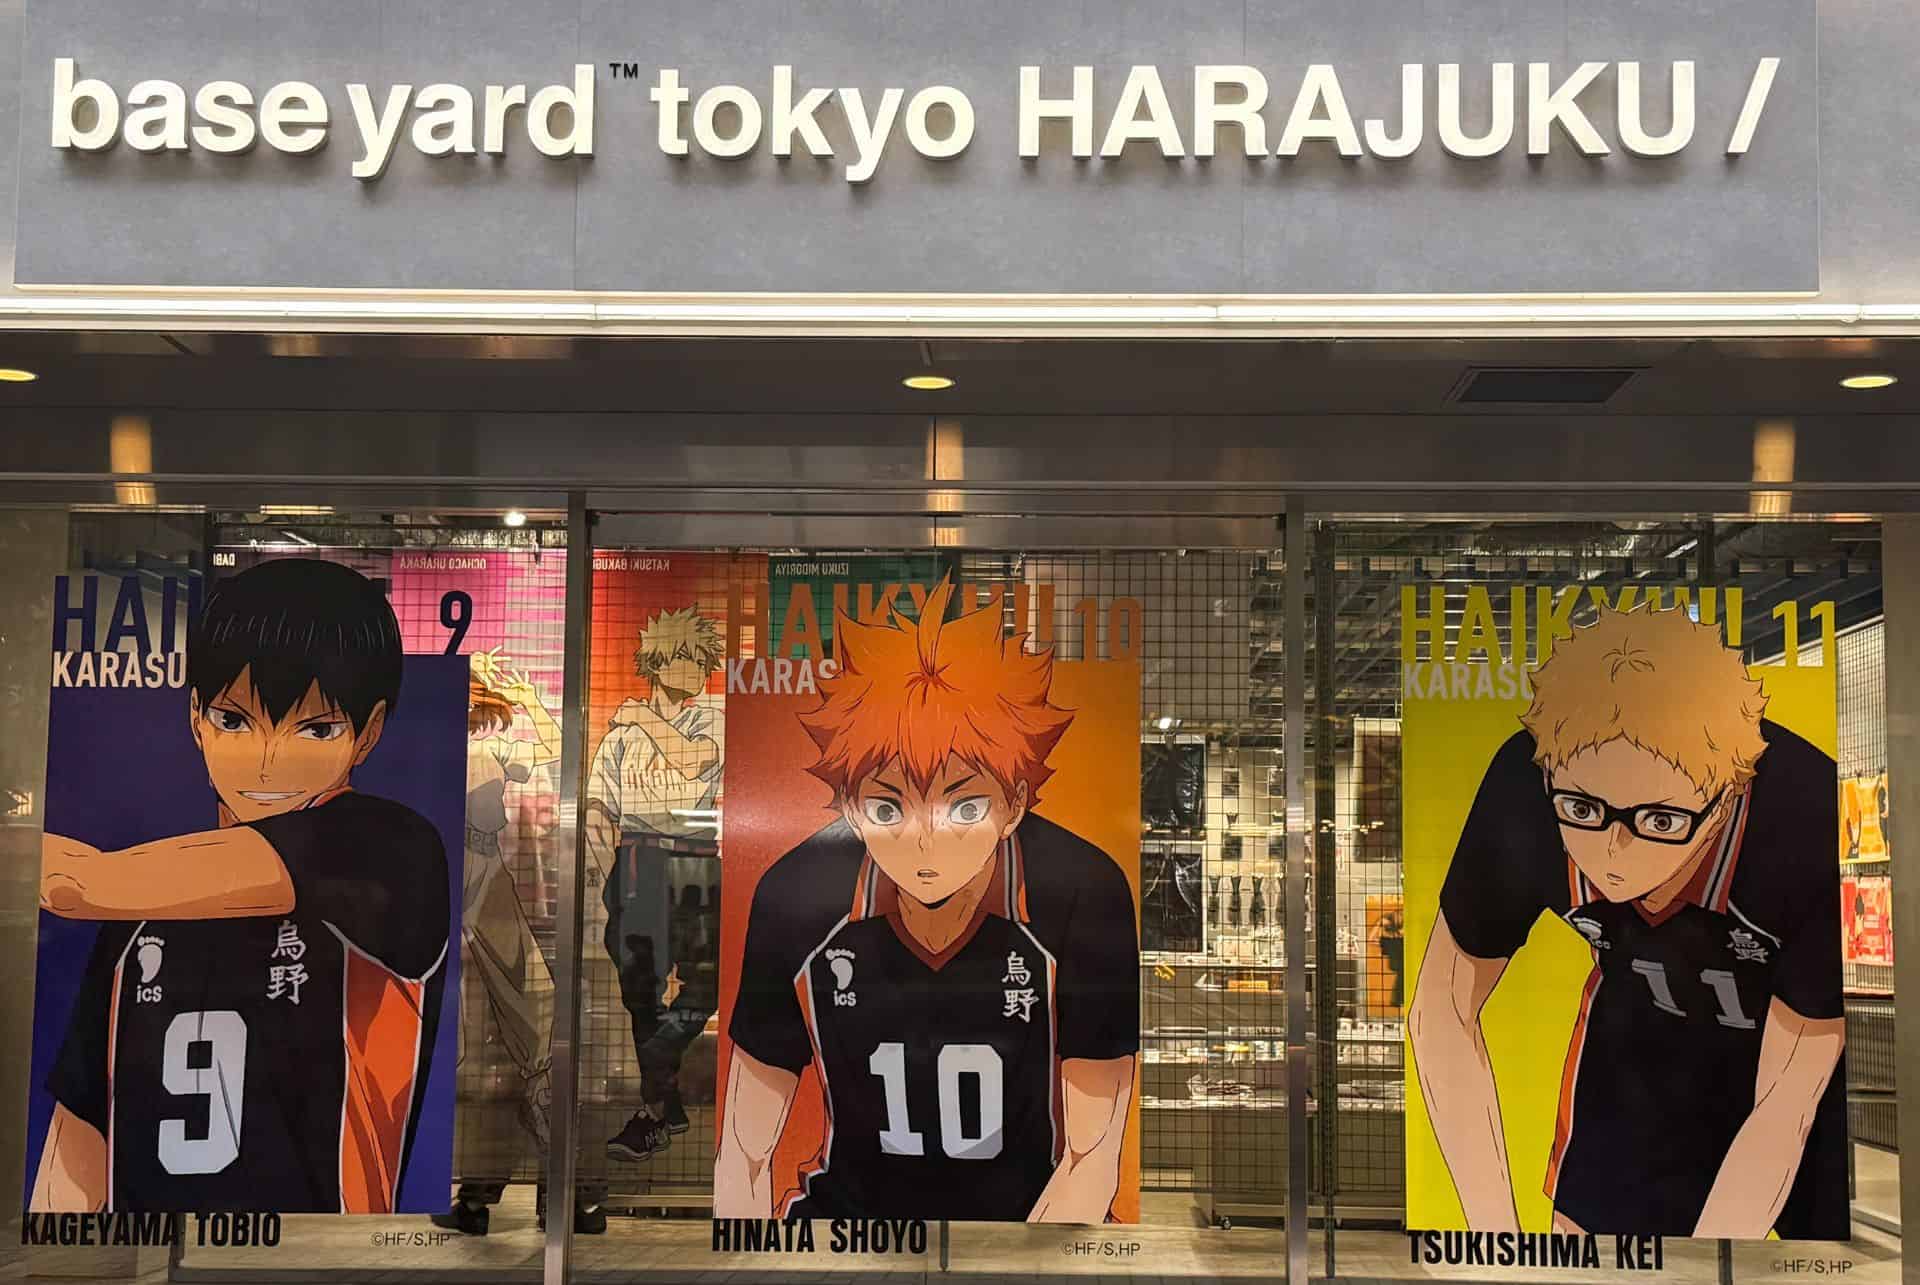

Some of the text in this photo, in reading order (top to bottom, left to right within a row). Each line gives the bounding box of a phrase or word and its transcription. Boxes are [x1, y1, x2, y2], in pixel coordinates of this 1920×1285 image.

[51, 57, 330, 156] base
[346, 64, 597, 181] yard
[649, 64, 976, 184] tokyo
[1017, 60, 1697, 159] HARAJUKU
[439, 590, 473, 656] 9
[1074, 597, 1142, 661] 10
[1772, 600, 1836, 667] 11
[52, 650, 188, 689] KARASU
[1631, 957, 1757, 1030] 11
[157, 1009, 248, 1176] 9
[868, 1041, 1004, 1160] 10
[20, 1211, 282, 1247] KAGEYAMA TOBIO
[711, 1217, 928, 1255] HINATA SHOYO
[1407, 1229, 1664, 1271] TSUKISHIMA KEI
